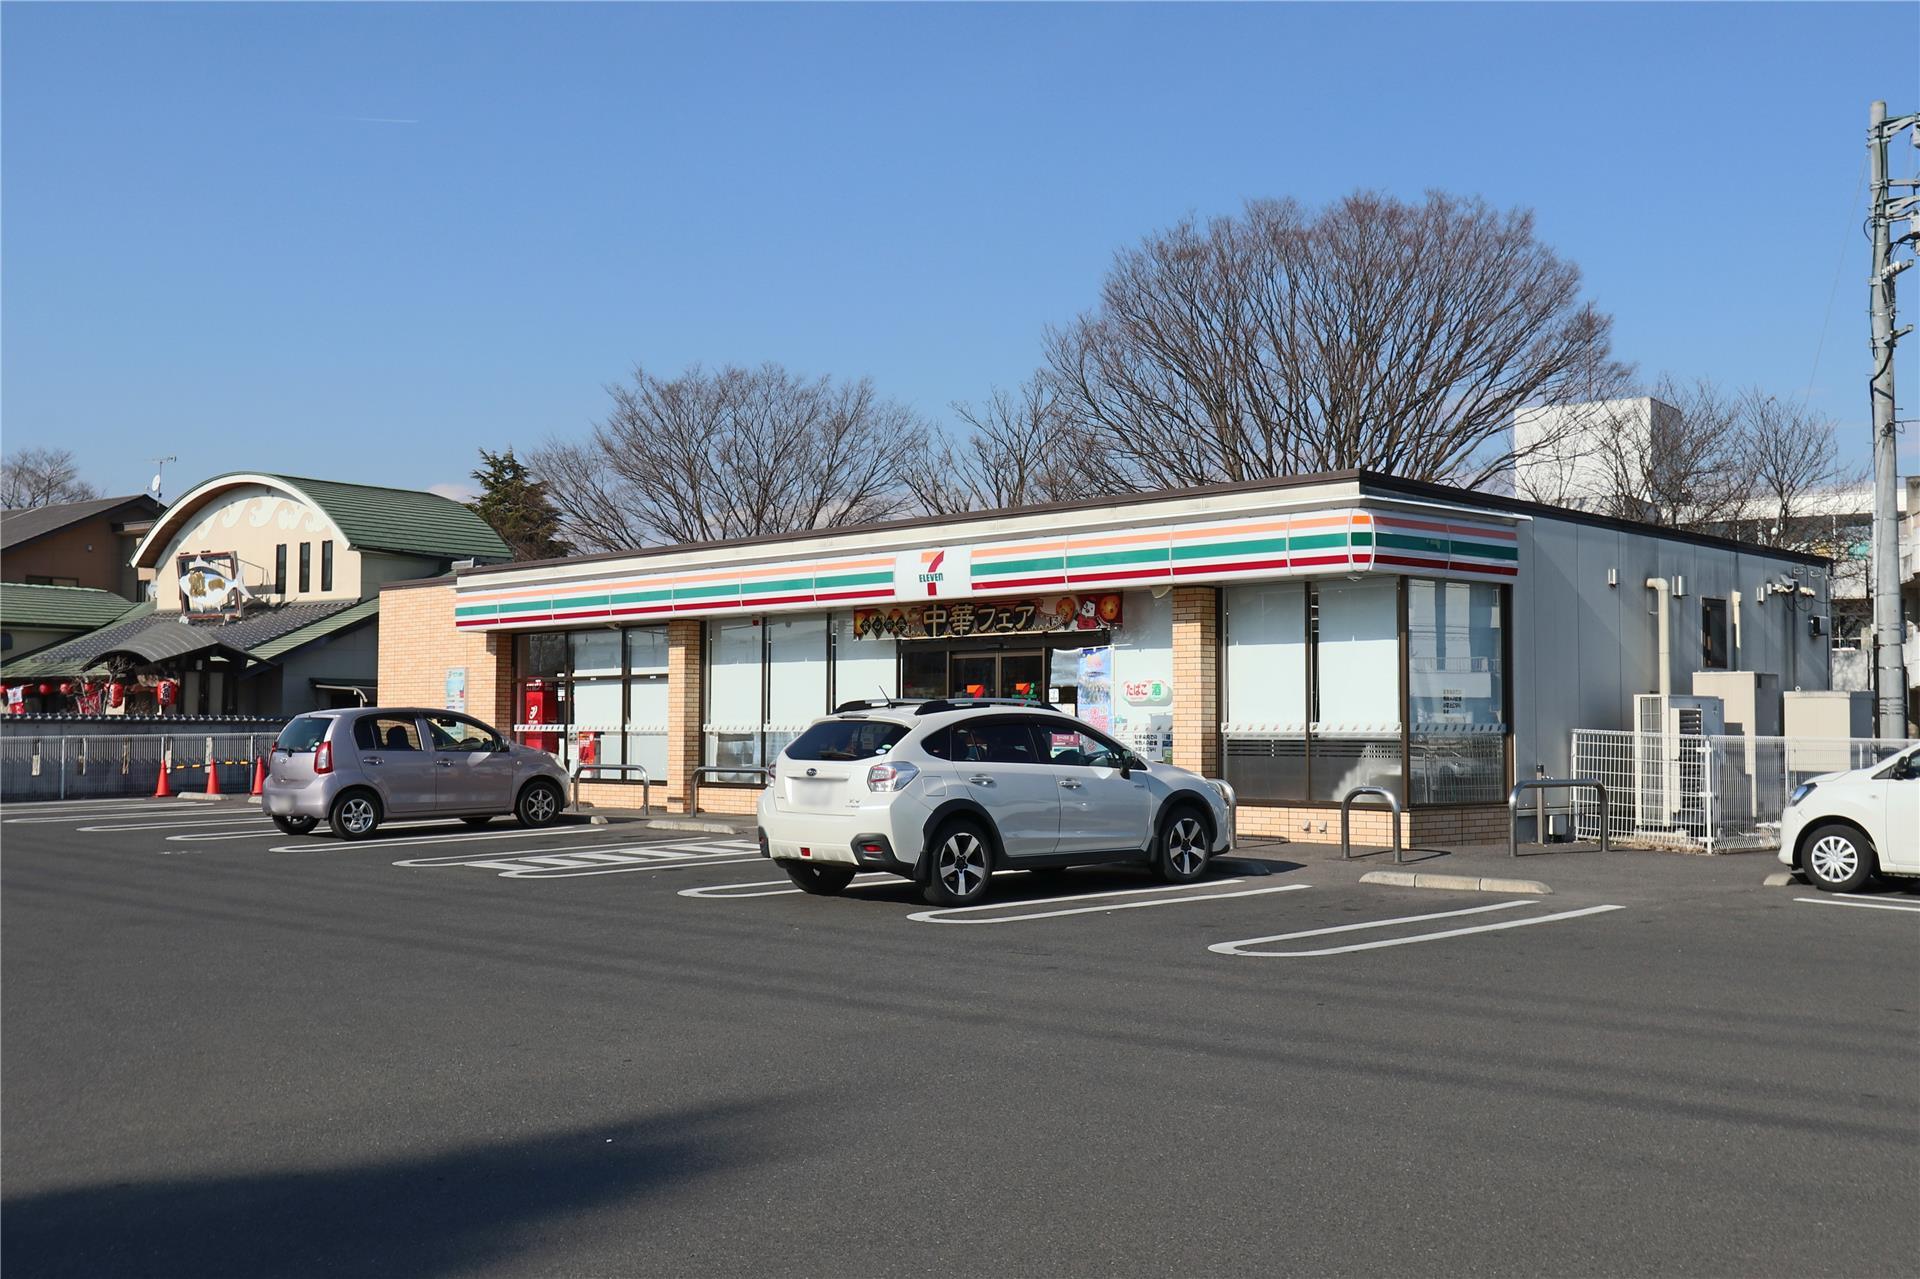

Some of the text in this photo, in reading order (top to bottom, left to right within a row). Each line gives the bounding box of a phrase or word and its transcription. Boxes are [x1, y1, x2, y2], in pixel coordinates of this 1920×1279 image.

[923, 603, 1036, 638] 中華フェア
[1126, 683, 1161, 696] たばこ 酒
